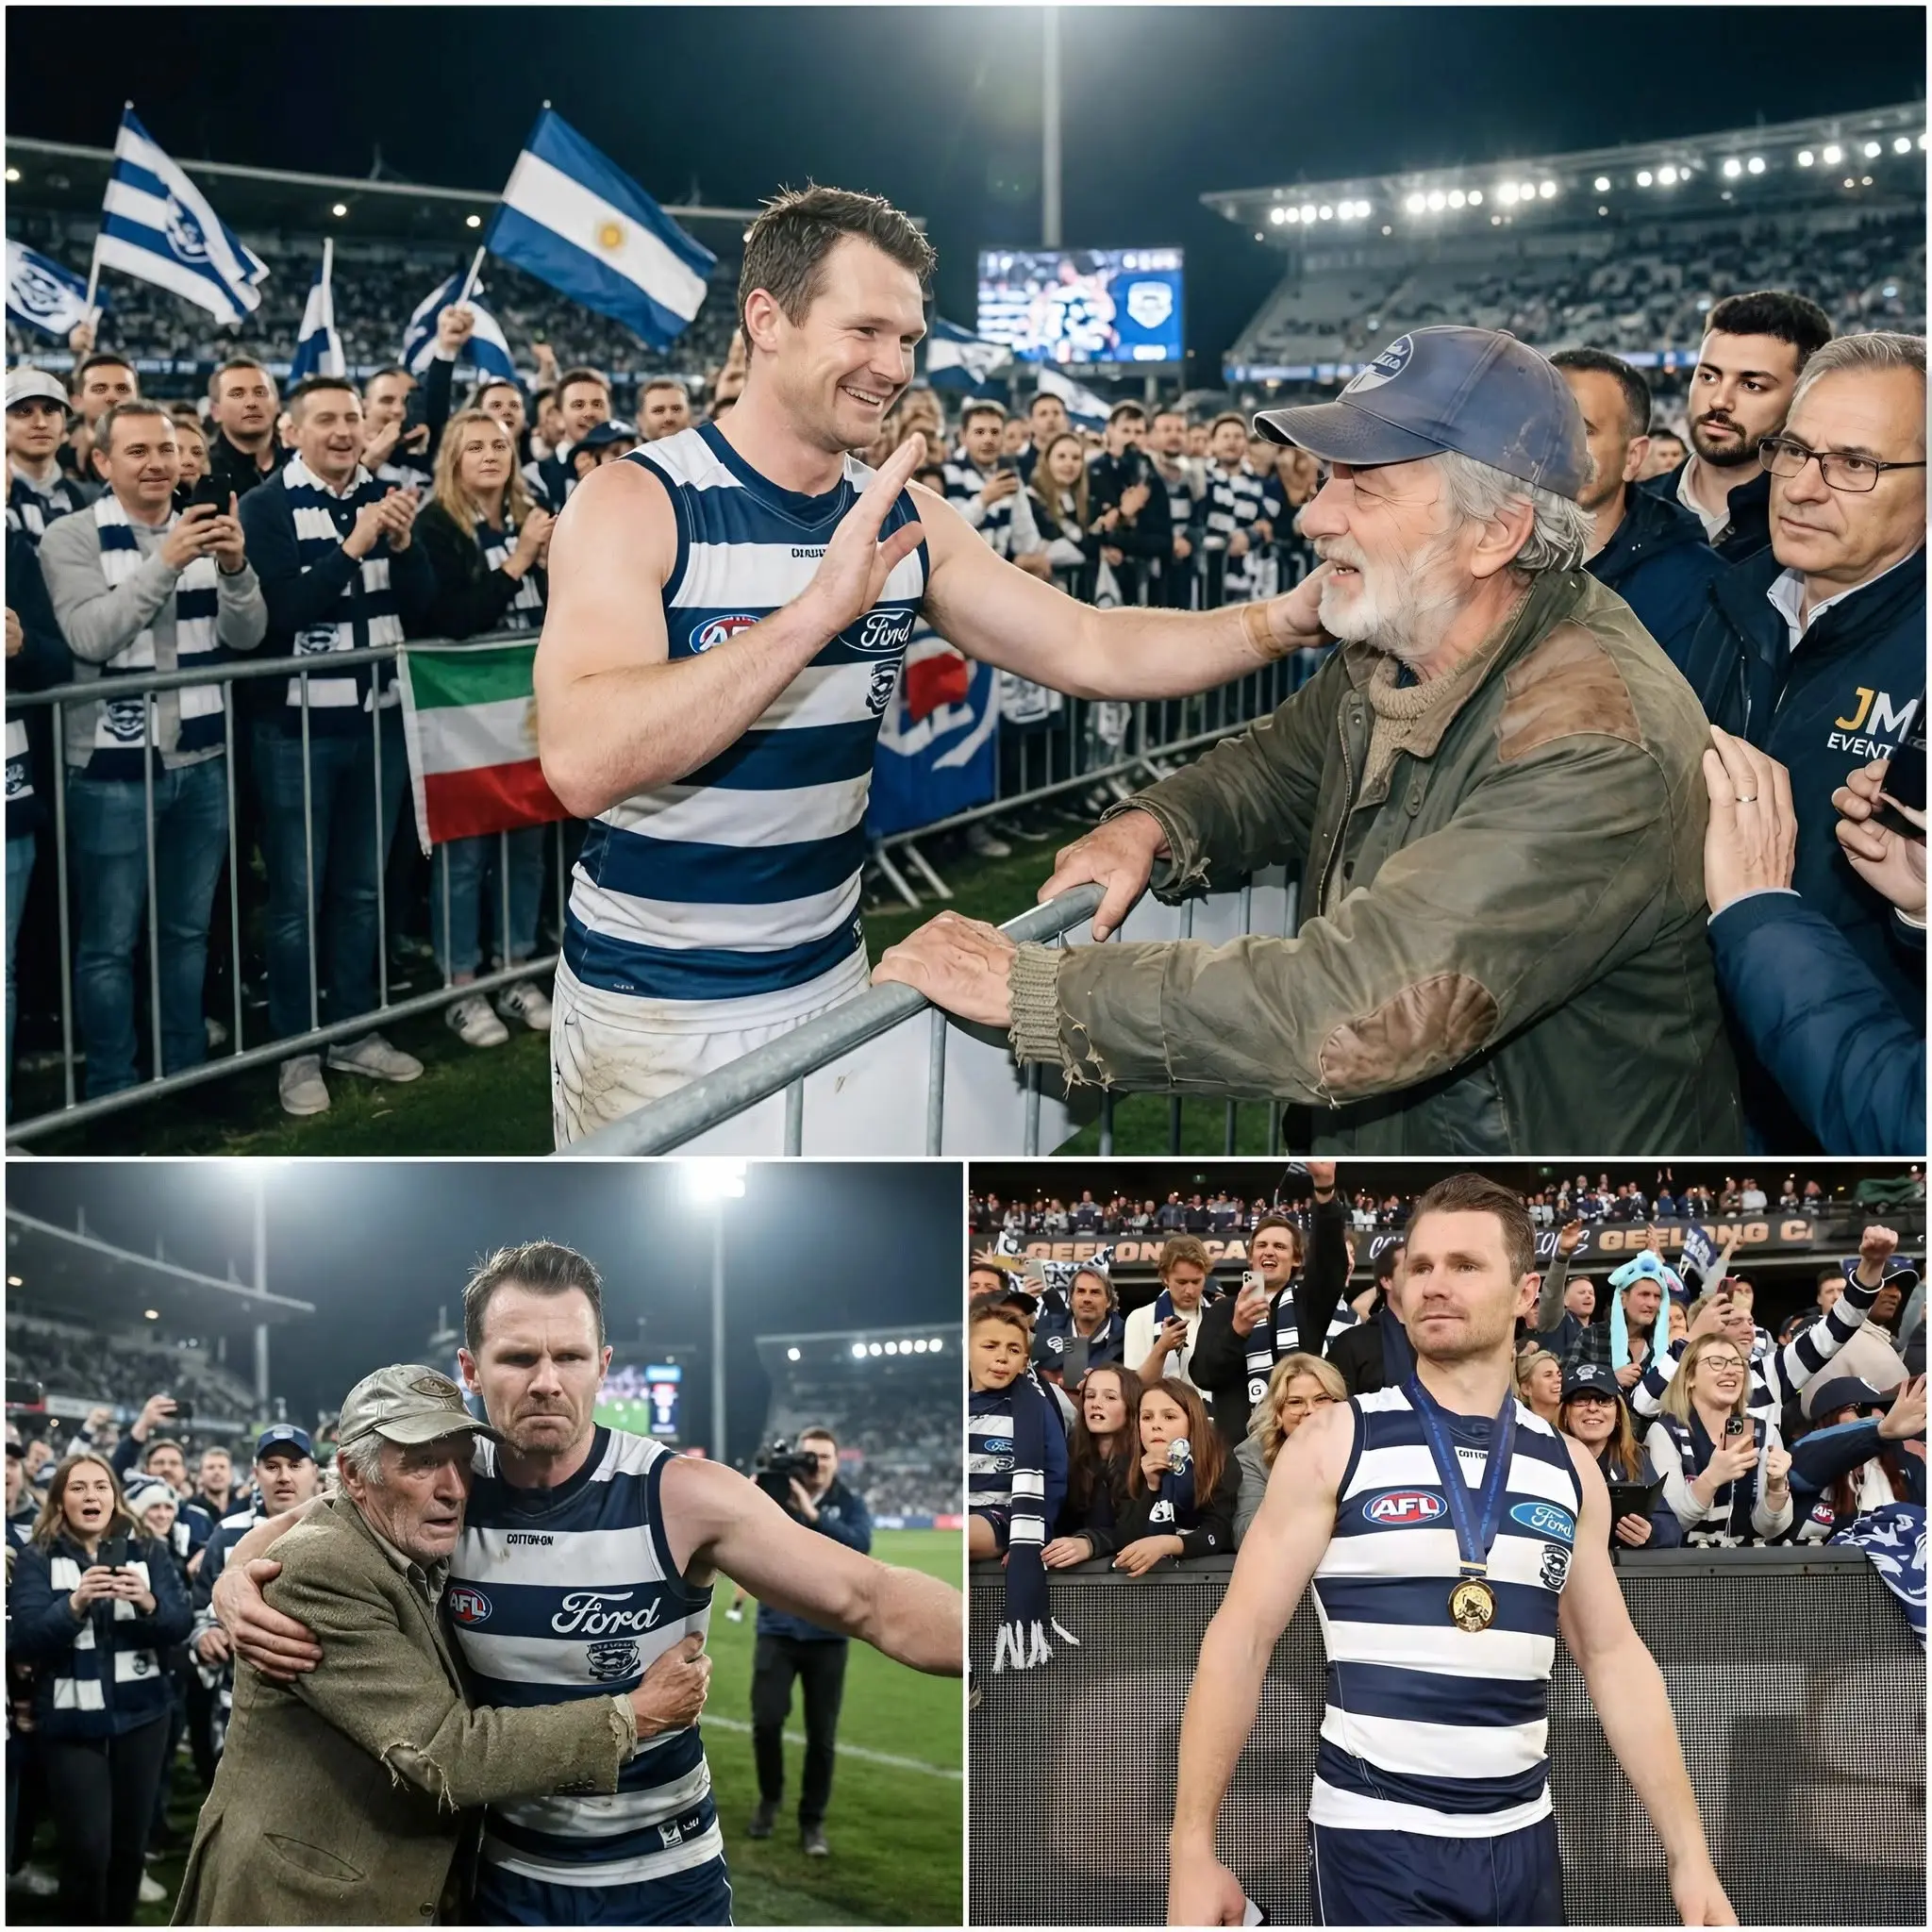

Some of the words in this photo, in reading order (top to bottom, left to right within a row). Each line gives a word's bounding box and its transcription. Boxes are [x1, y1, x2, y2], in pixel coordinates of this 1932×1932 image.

[1835, 686, 1919, 743] JM
[1780, 1220, 1813, 1241] C
[1025, 1241, 1166, 1262] GEEON
[1201, 1240, 1250, 1260] CA
[1371, 1497, 1441, 1519] AFL
[1531, 1506, 1573, 1539] Ford
[450, 1591, 487, 1617] AFL
[551, 1591, 661, 1635] Ford
